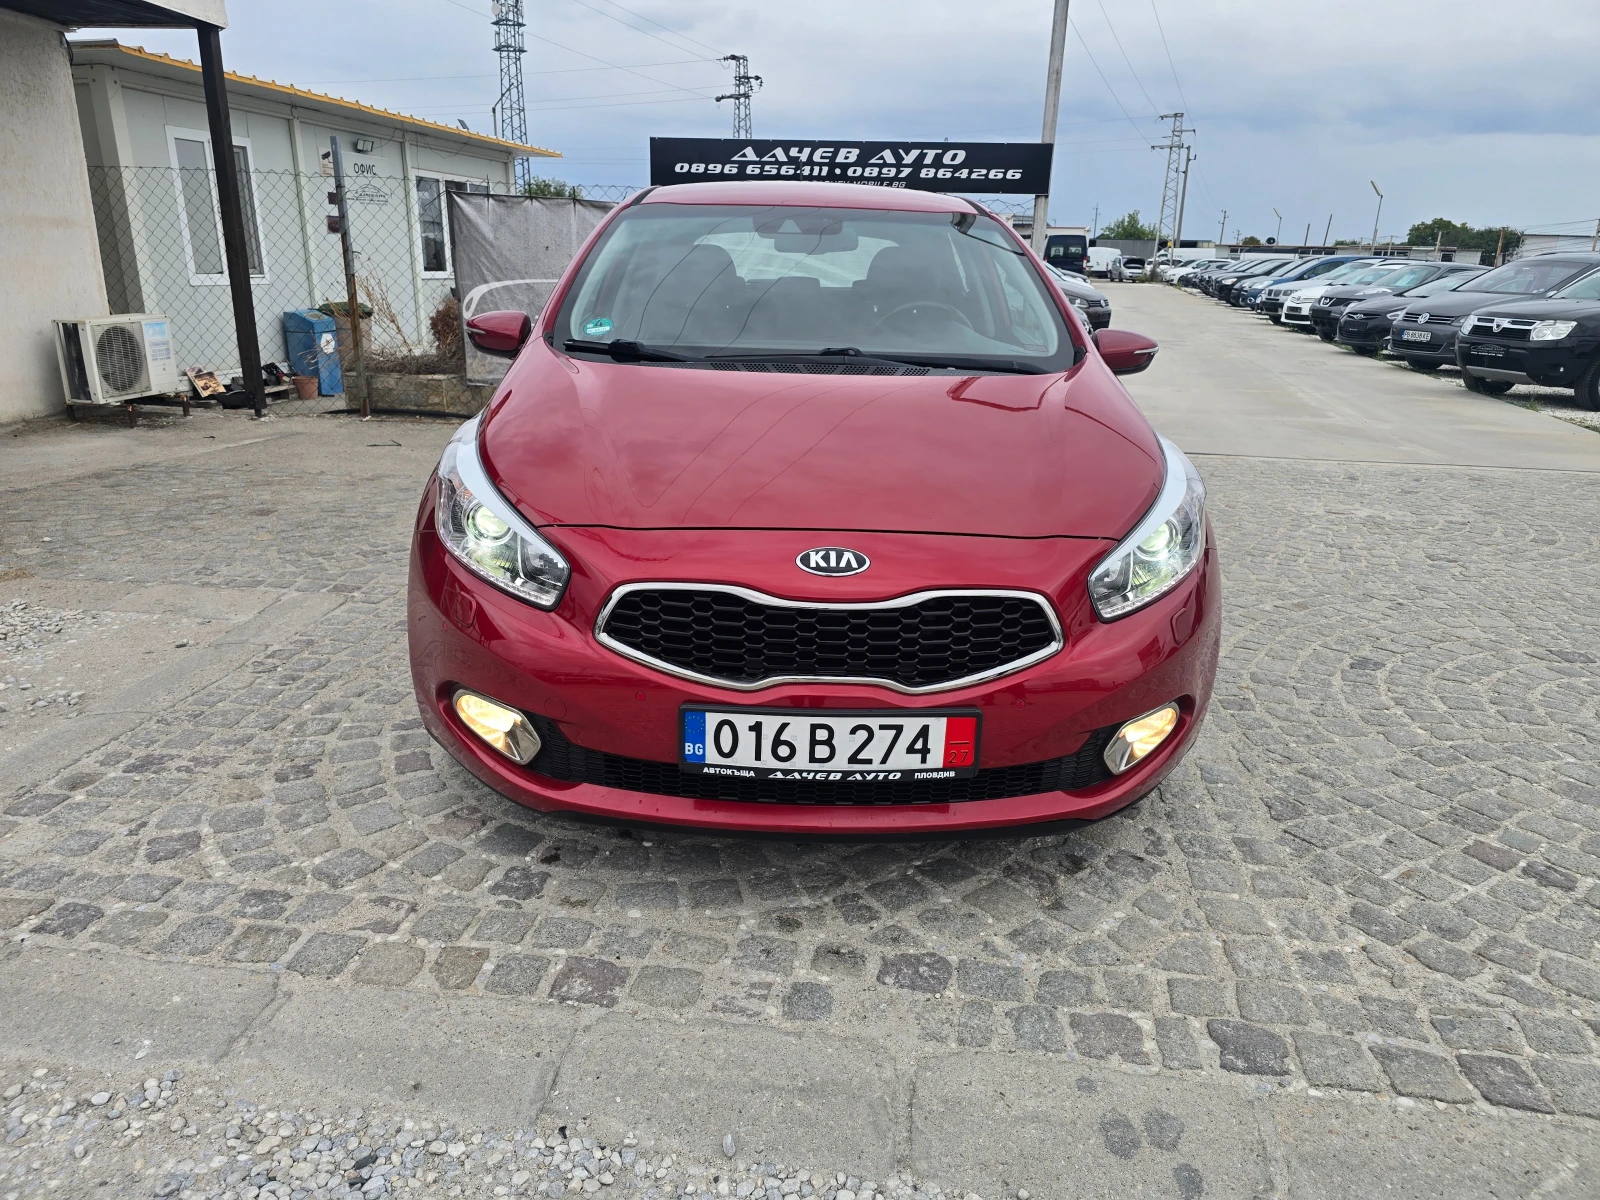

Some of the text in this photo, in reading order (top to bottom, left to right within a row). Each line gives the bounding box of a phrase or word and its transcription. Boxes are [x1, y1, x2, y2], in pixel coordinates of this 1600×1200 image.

[868, 148, 967, 165] АУТО
[353, 162, 377, 175] ОФИС
[674, 163, 1023, 179] 0896 656411 0897 864266
[809, 550, 859, 569] KIA
[684, 742, 704, 756] BG
[948, 750, 968, 764] 27
[702, 766, 756, 778] АВТОКЪЩА
[846, 772, 902, 781] АУТО
[914, 770, 956, 780] ПЛОВДИВ
